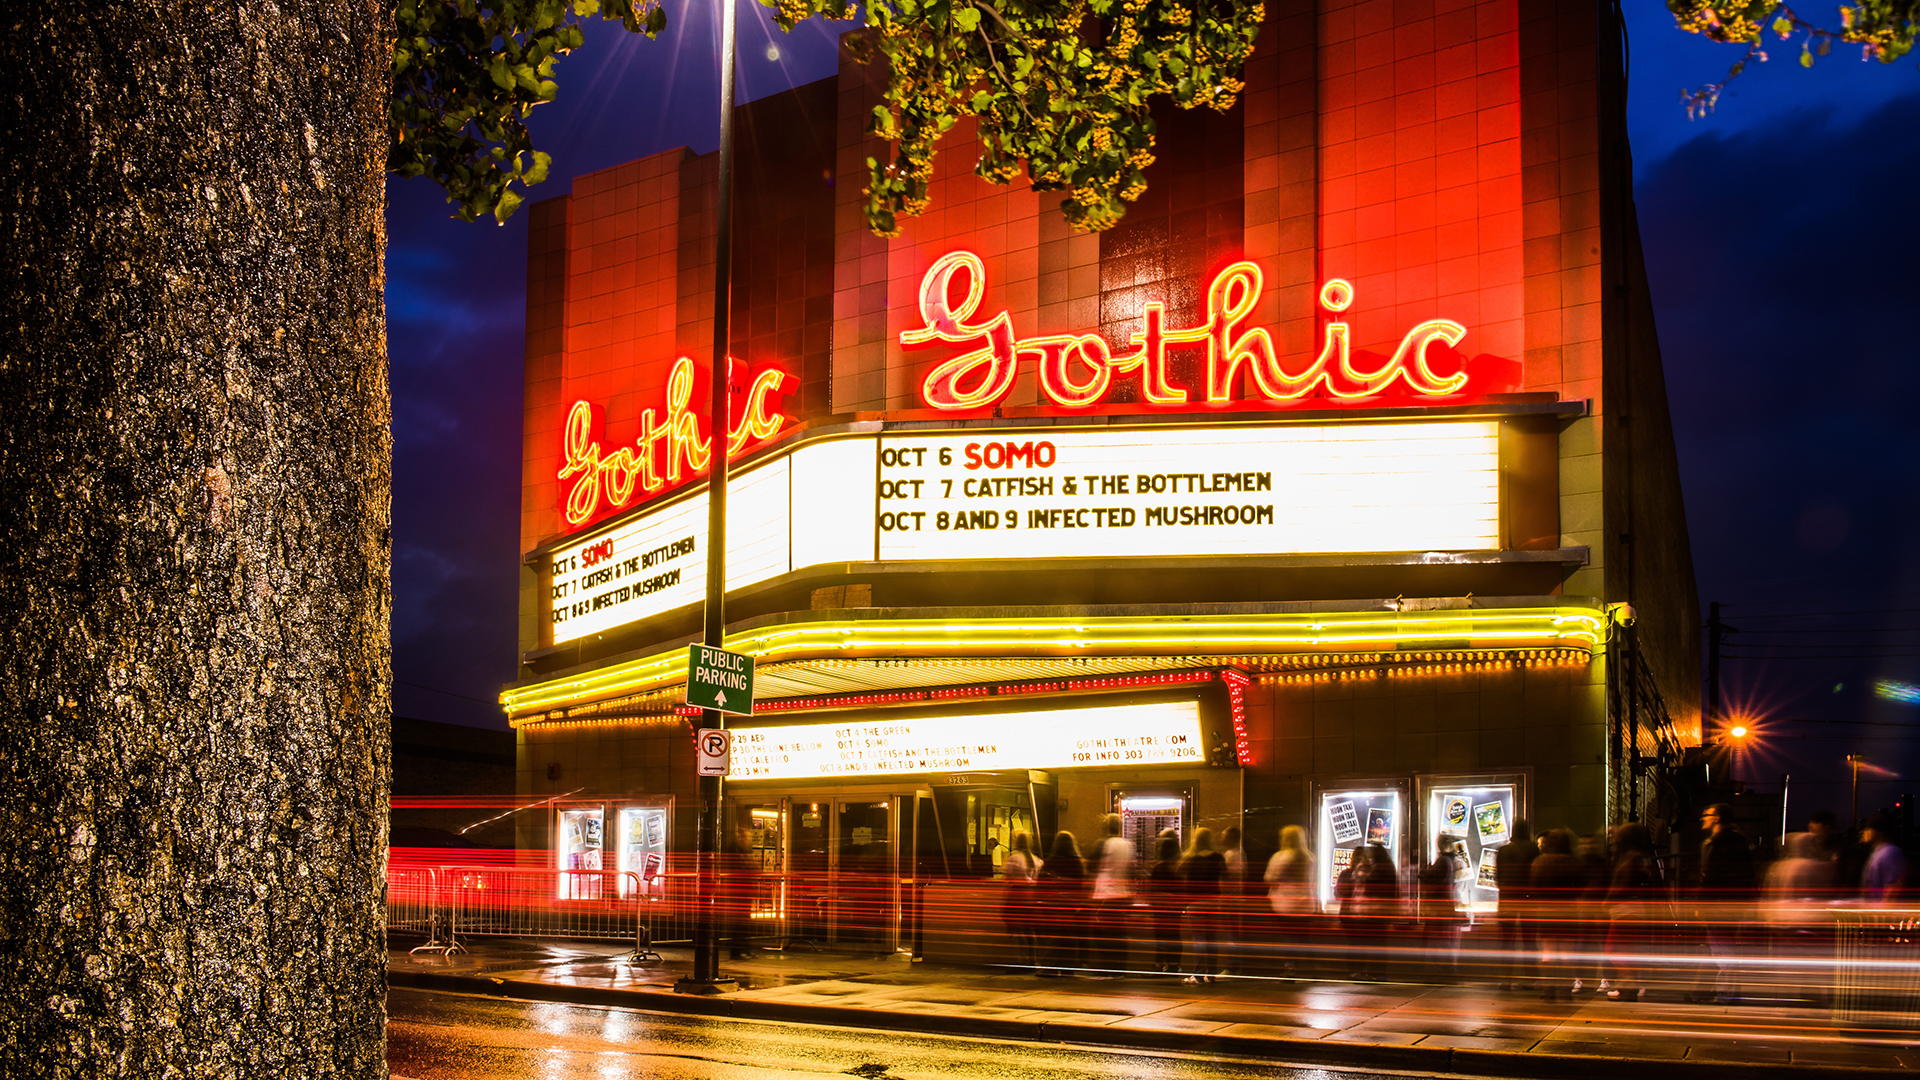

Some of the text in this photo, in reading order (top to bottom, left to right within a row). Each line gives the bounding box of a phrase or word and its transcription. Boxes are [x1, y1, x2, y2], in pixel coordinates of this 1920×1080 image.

[900, 250, 1468, 410] Gothic
[558, 356, 786, 525] Gothc
[881, 440, 1056, 470] OCT 6 SOMO
[880, 472, 1271, 499] OCT 7 CATFISH & THE BOTTLEMEN
[880, 511, 926, 531] OCT
[1005, 509, 1018, 529] 9
[1027, 507, 1136, 529] INFECTED
[1145, 505, 1274, 527] MUSHROOM
[552, 538, 613, 576] OCT 6 SOMO
[552, 582, 569, 599] OCT
[572, 579, 577, 594] 7
[581, 566, 613, 590] CATFISH
[622, 556, 640, 576] THE
[641, 535, 695, 570] BOTTLEMEN
[552, 606, 569, 623] OCT
[592, 586, 630, 612] INFECTED
[632, 567, 681, 599] MUSHROOM
[701, 649, 744, 672] PUBLIC
[696, 666, 747, 691] PARKING
[738, 735, 747, 744] 29
[751, 734, 765, 743] AER
[836, 729, 851, 738] OCT
[864, 727, 879, 736] THE
[883, 726, 910, 735] GREEN
[741, 745, 750, 754] 30
[752, 745, 766, 753] THE
[769, 744, 788, 752] LONE
[791, 742, 822, 751] BELLOW
[838, 740, 852, 749] OCT
[865, 739, 889, 748] SOMO
[1077, 735, 1186, 749] GOTHICTHEATRE COM
[751, 754, 789, 764] CALEXICO
[840, 745, 996, 760] OCT 7 CATFISH AND THE BOTTLEMEN
[1073, 752, 1091, 761] FOR
[1096, 751, 1119, 760] INFO
[1125, 750, 1143, 759] 303
[1170, 747, 1195, 757] 9206
[745, 767, 750, 775] 3
[820, 763, 834, 772] OCT
[845, 763, 860, 771] AND
[874, 760, 914, 769] INFECTED
[920, 758, 969, 768] MUSHROOM
